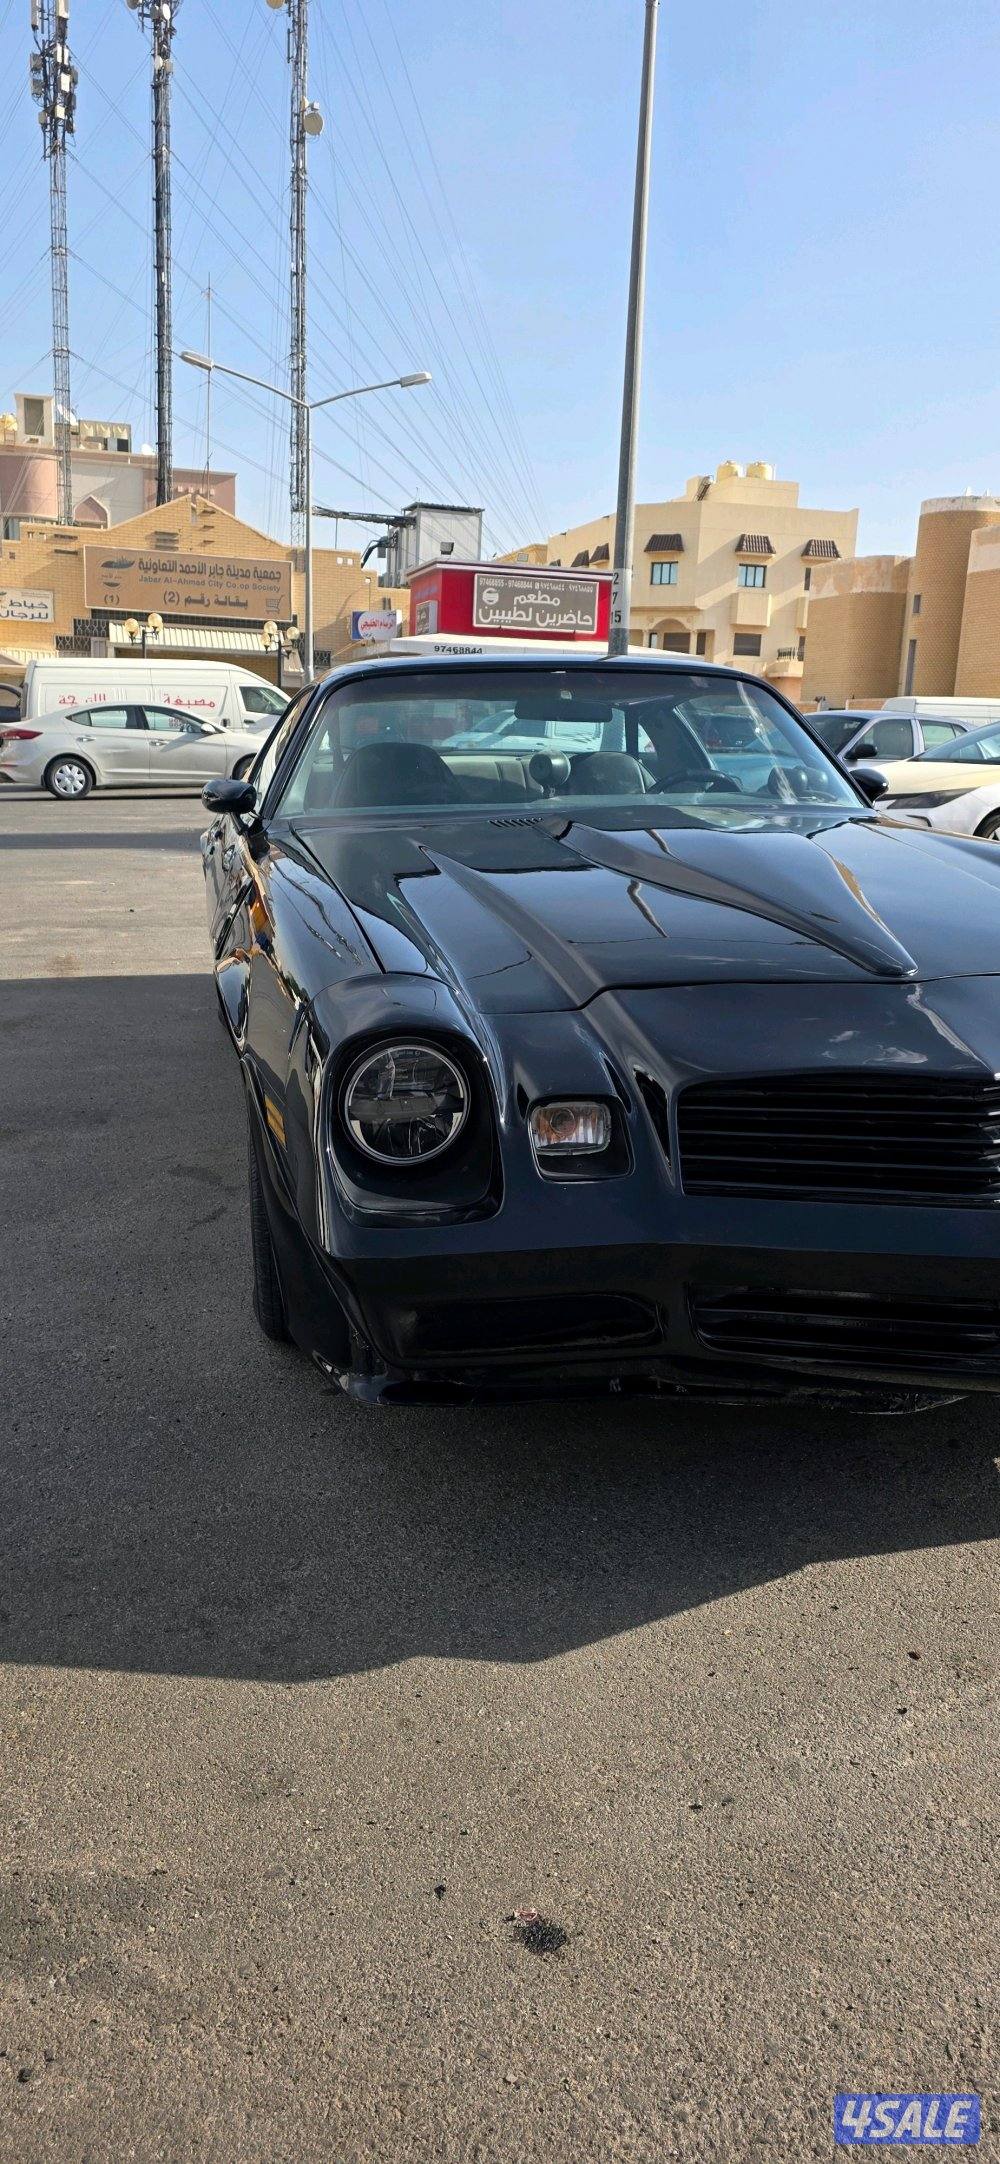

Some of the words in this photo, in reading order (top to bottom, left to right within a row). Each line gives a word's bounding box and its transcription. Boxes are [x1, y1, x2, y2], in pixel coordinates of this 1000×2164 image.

[138, 557, 178, 574] التعاونية
[179, 560, 206, 575] الأحمد
[208, 562, 225, 579] جابر
[226, 564, 251, 580] مدينة
[253, 566, 281, 583] جمعية
[208, 579, 224, 590] City
[252, 583, 281, 593] Society
[9, 600, 48, 610] خياط
[162, 590, 180, 606] (2)
[184, 592, 211, 608] رقم
[213, 594, 249, 611] بقالة
[514, 590, 560, 606] مطعم
[479, 606, 533, 623] لطيبين
[535, 610, 593, 627] حاضرين
[434, 645, 483, 656] 97468844
[163, 692, 216, 709] مصبغة
